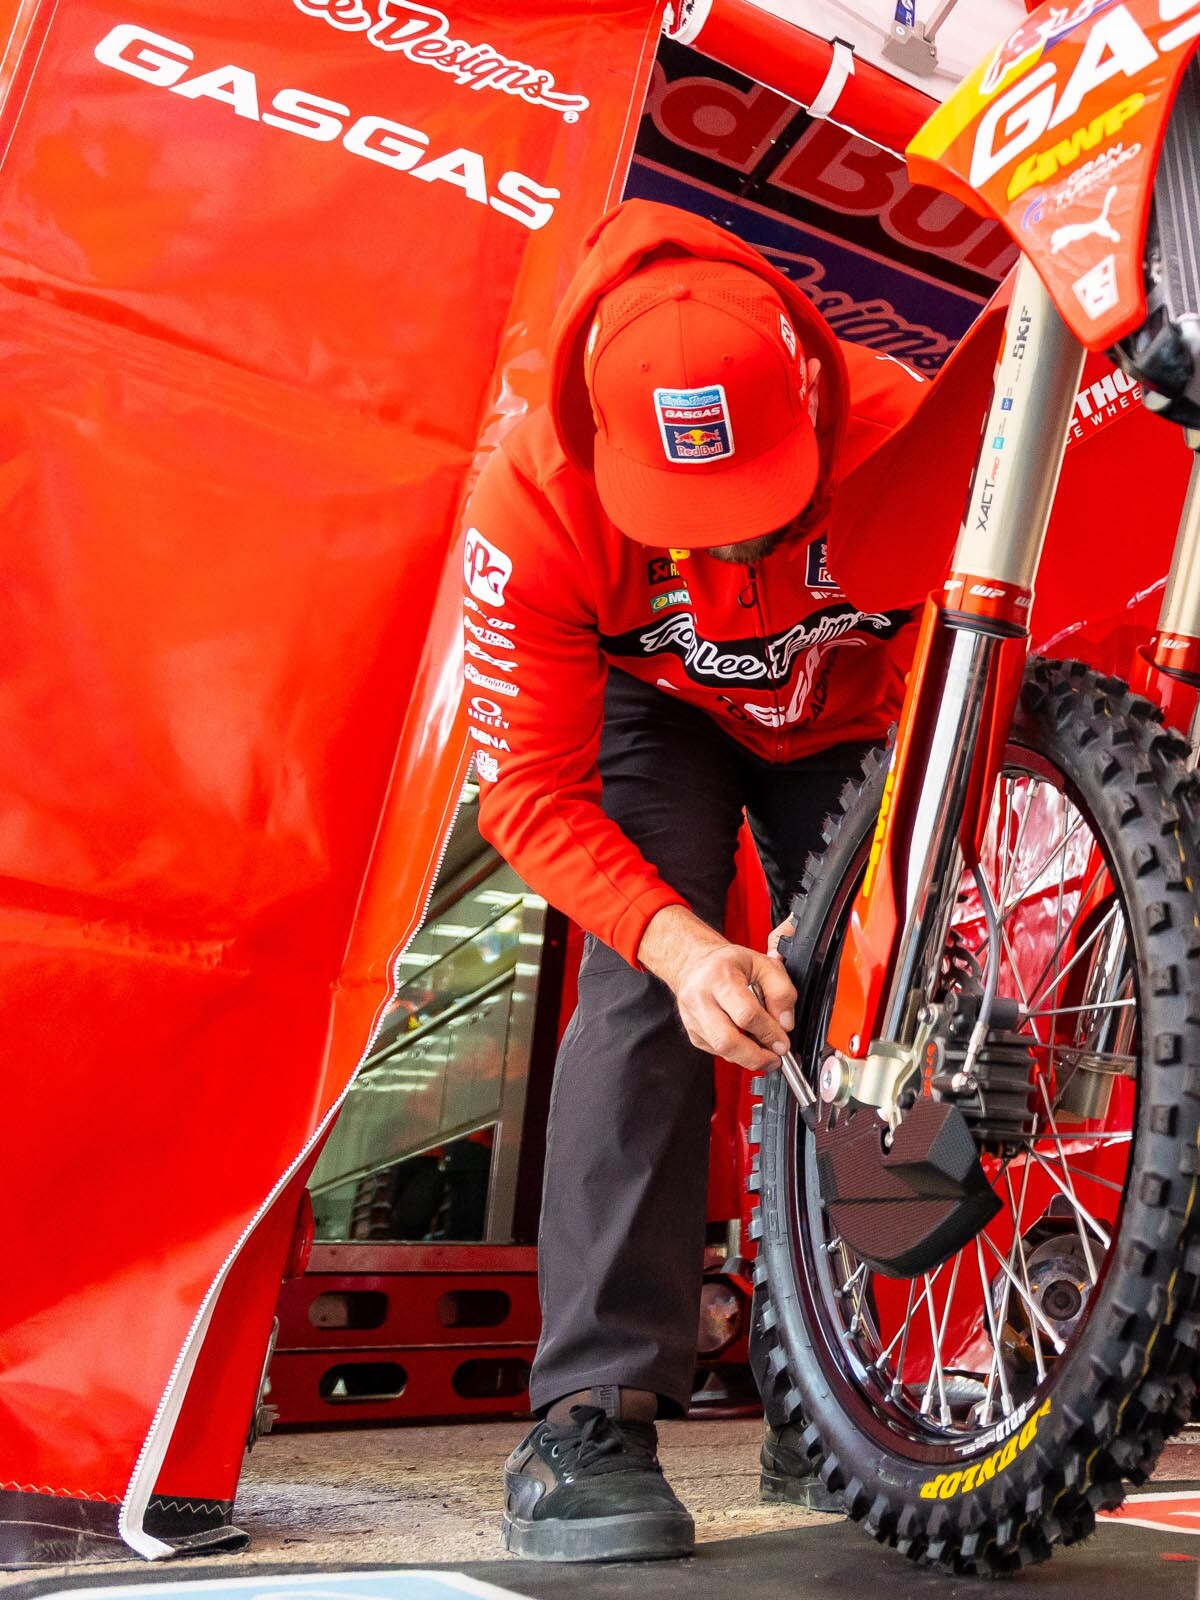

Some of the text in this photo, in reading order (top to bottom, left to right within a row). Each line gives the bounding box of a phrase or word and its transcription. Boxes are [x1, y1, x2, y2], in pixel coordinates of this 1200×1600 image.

[367, 0, 590, 112] Designs
[94, 23, 561, 231] GASGAS
[1066, 142, 1123, 187] GRAN
[1012, 305, 1032, 360] SKF
[664, 406, 721, 419] GASGAS
[676, 443, 723, 457] Red Bull
[976, 479, 995, 532] XACT
[969, 584, 1006, 599] WP
[692, 640, 770, 682] Lee
[1161, 638, 1191, 650] WP
[920, 1405, 1044, 1500] DUNLOP
